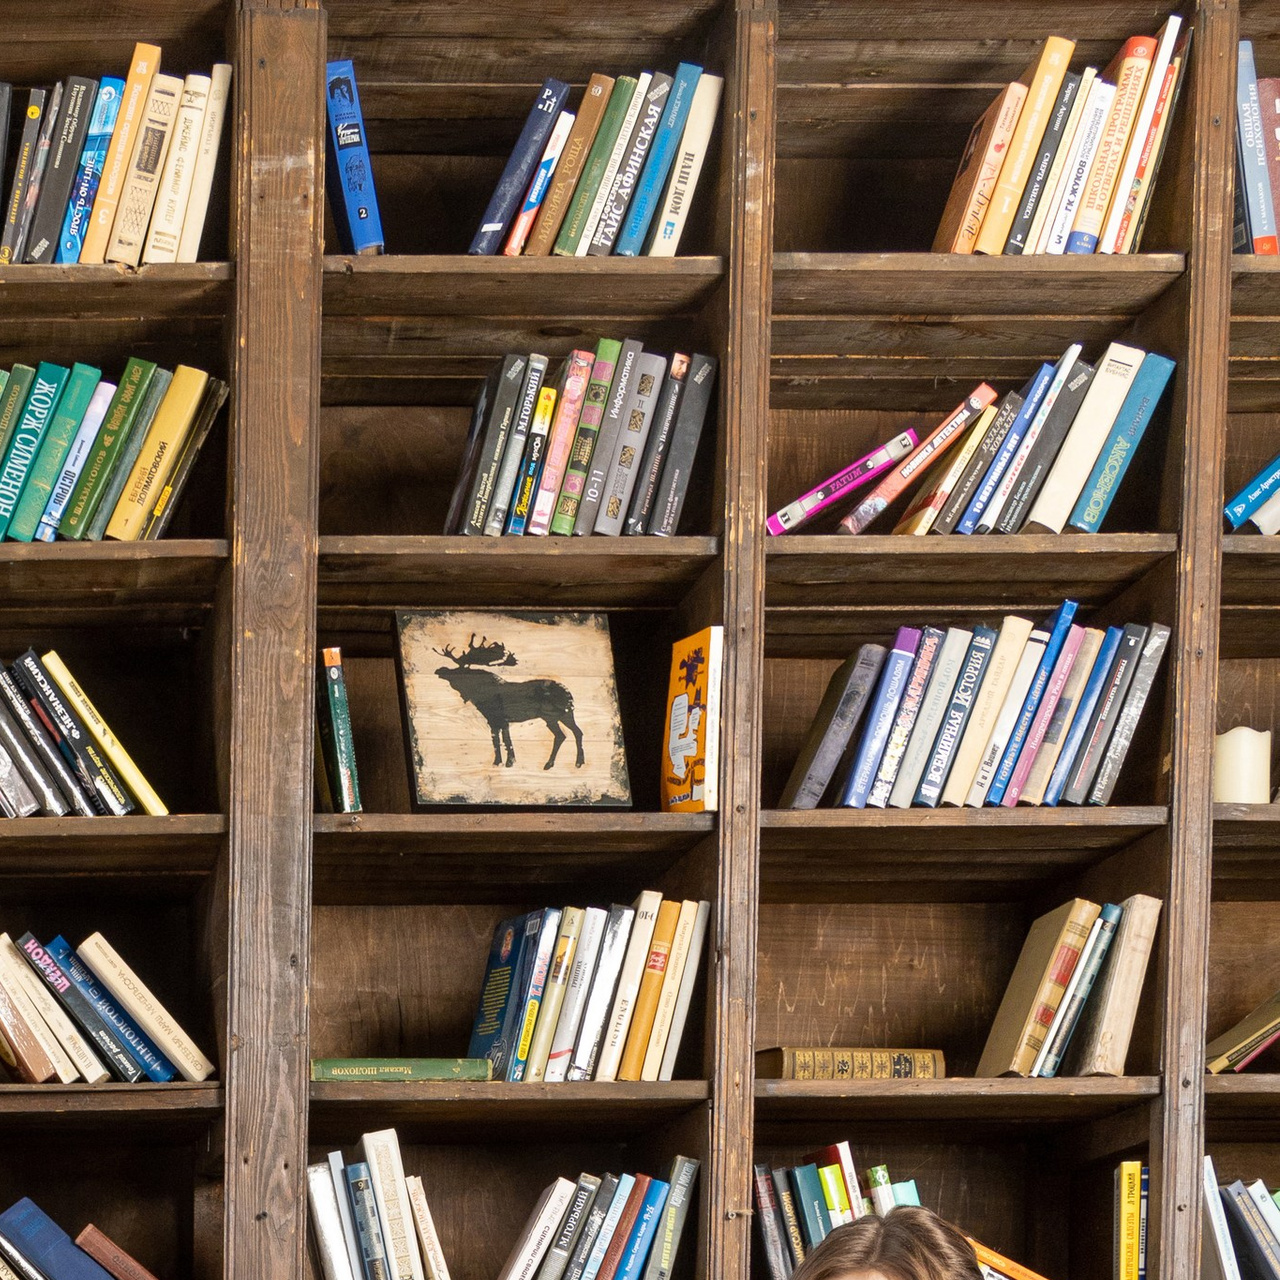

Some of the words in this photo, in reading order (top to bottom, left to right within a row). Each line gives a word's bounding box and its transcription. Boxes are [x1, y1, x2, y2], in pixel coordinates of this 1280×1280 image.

[1061, 81, 1076, 106] Борис
[176, 116, 193, 152] ДЖЕЙМС
[1052, 104, 1069, 132] Акунин
[1085, 139, 1114, 210] ШКОЛЬНАЯ
[1107, 63, 1137, 139] ПРОГРАММА
[1099, 149, 1122, 202] ОТВЕТАХ
[1117, 65, 1145, 136] РЕШЕНИЯХ
[1240, 102, 1254, 147] ОБЩАЯ
[1247, 82, 1265, 165] ПСИХОЛОГИЯ
[167, 157, 185, 194] ФЕНИМОР
[599, 201, 627, 247] ТАИС
[616, 103, 661, 199] АФИНСКАЯ
[676, 151, 694, 186] НАШ
[1034, 151, 1051, 182] СМЕРТЬ
[1069, 159, 1087, 197] ЖУКОВ
[537, 182, 567, 243] МАРЬИНА
[559, 133, 583, 176] РОЩА
[600, 172, 622, 221] ЕФРЕМОВ
[668, 187, 685, 216] ДОМ
[1022, 182, 1041, 220] АХИЛЛЕСА
[162, 198, 176, 223] КУПЕР
[593, 221, 608, 245] Иван
[516, 369, 542, 432] М.ГОРЬКИЙ
[608, 350, 637, 419] Информатика
[19, 377, 58, 435] ЖОРЖ
[900, 442, 937, 478] НОВИНКИ
[930, 408, 972, 449] ДЕТЕКТИВА
[1005, 431, 1022, 453] ЛЕТ
[135, 440, 171, 506] ДОЛМАТОВСКИЙ
[584, 467, 606, 504] 10-11
[828, 467, 863, 492] FATUM
[977, 450, 1012, 503] БЕЗУМНЫХ
[1082, 434, 1131, 526] АКСЕНОВ
[470, 498, 482, 526] Алексей
[476, 472, 489, 498] Толстой
[971, 500, 984, 514] 10
[22, 655, 82, 742] Ф.НЕЗНАНСКИЙ
[926, 709, 964, 784] ВСЕМИРНАЯ
[953, 650, 985, 708] ИСТОРИЯ
[98, 1027, 120, 1054] расчет
[113, 1050, 136, 1077] Тонкий
[331, 1066, 377, 1075] ШОЛОХОВ
[379, 1066, 411, 1074] Михаил
[558, 1188, 588, 1247] М.ГОРЬКИЙ
[782, 1190, 797, 1224] МАФИИ
